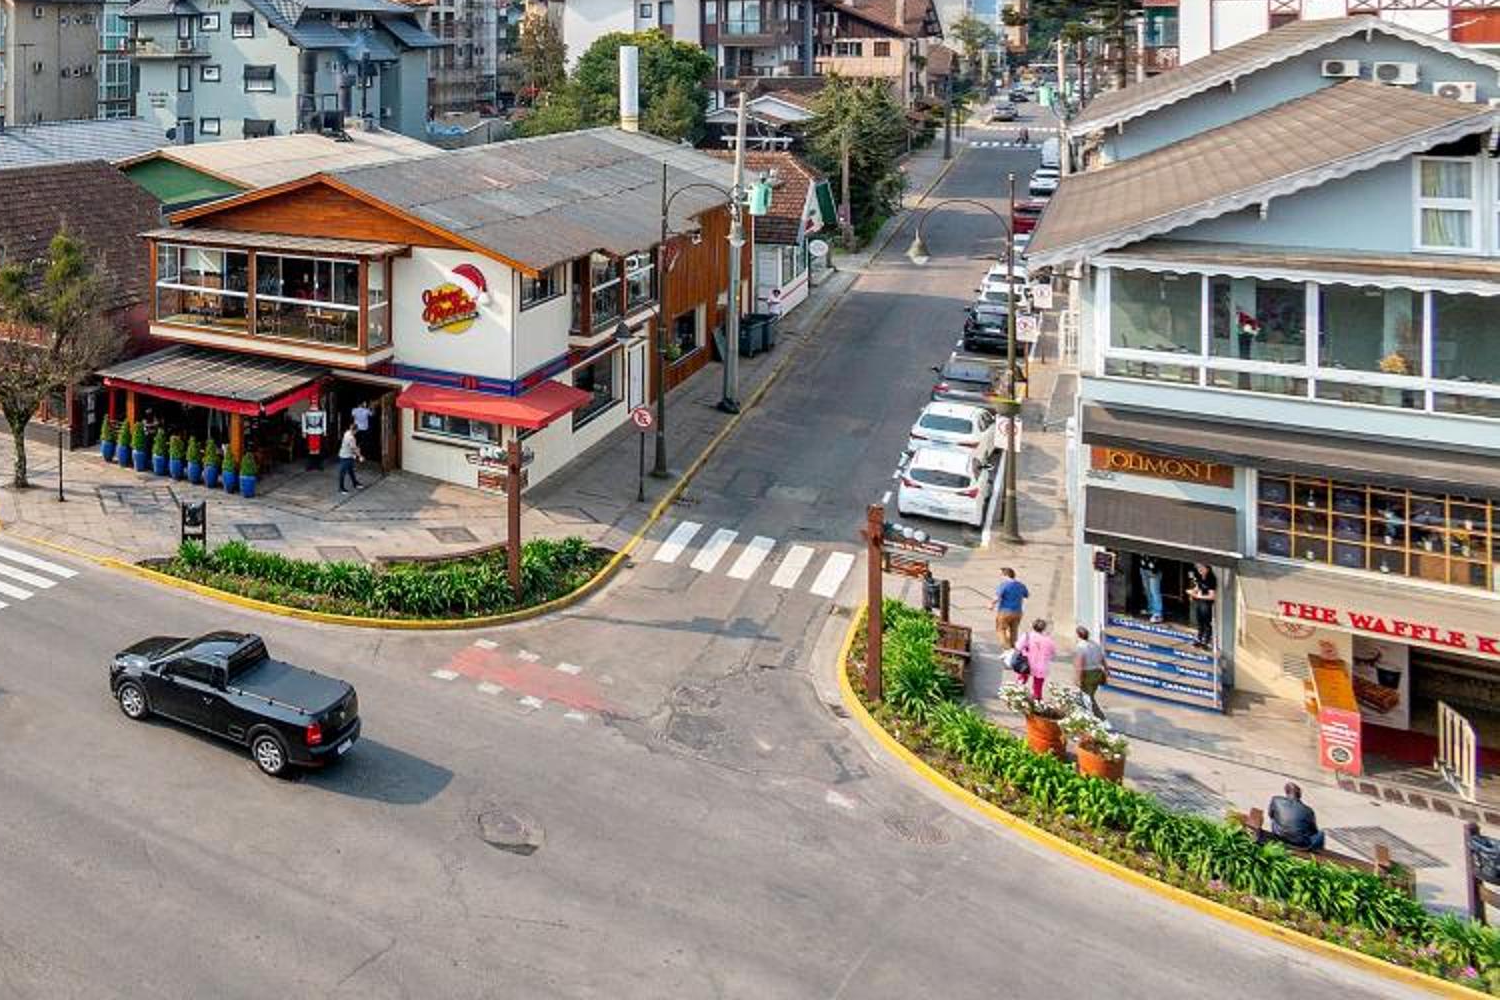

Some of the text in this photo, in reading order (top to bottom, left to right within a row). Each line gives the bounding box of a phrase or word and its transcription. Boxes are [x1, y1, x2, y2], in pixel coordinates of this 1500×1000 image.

[1104, 448, 1217, 480] JOLIMONT
[1278, 601, 1340, 626] THE
[1348, 612, 1468, 650] WAFFLE
